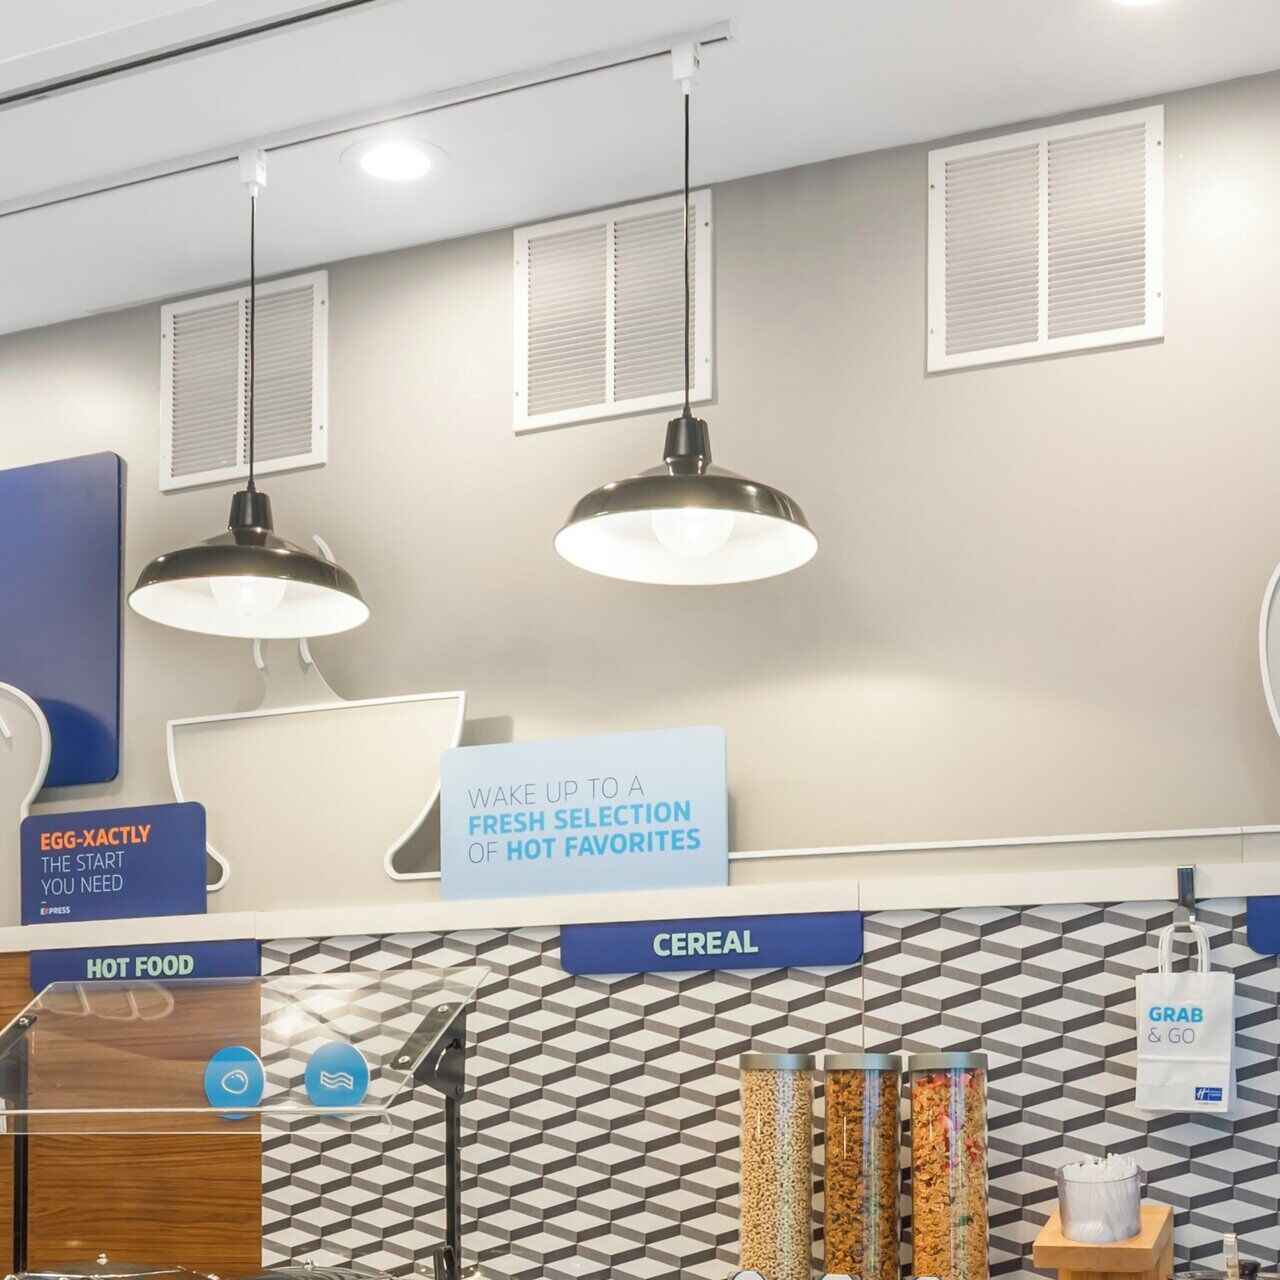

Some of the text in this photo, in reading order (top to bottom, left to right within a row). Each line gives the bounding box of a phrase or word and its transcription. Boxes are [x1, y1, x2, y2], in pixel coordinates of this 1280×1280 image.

[467, 775, 645, 809] WAKE UP TO A
[468, 800, 692, 836] FRESH SELECTION
[40, 824, 152, 850] EGG-XACTLY
[468, 827, 702, 864] OF HOT FAVORITES
[41, 851, 126, 874] THE START
[41, 874, 124, 896] YOU NEED
[40, 906, 71, 916] EXPRESS
[653, 929, 760, 957] CEREAL
[86, 954, 195, 979] HOT FOOD
[1148, 1006, 1204, 1023] GRAB
[1147, 1026, 1195, 1044] & GO
